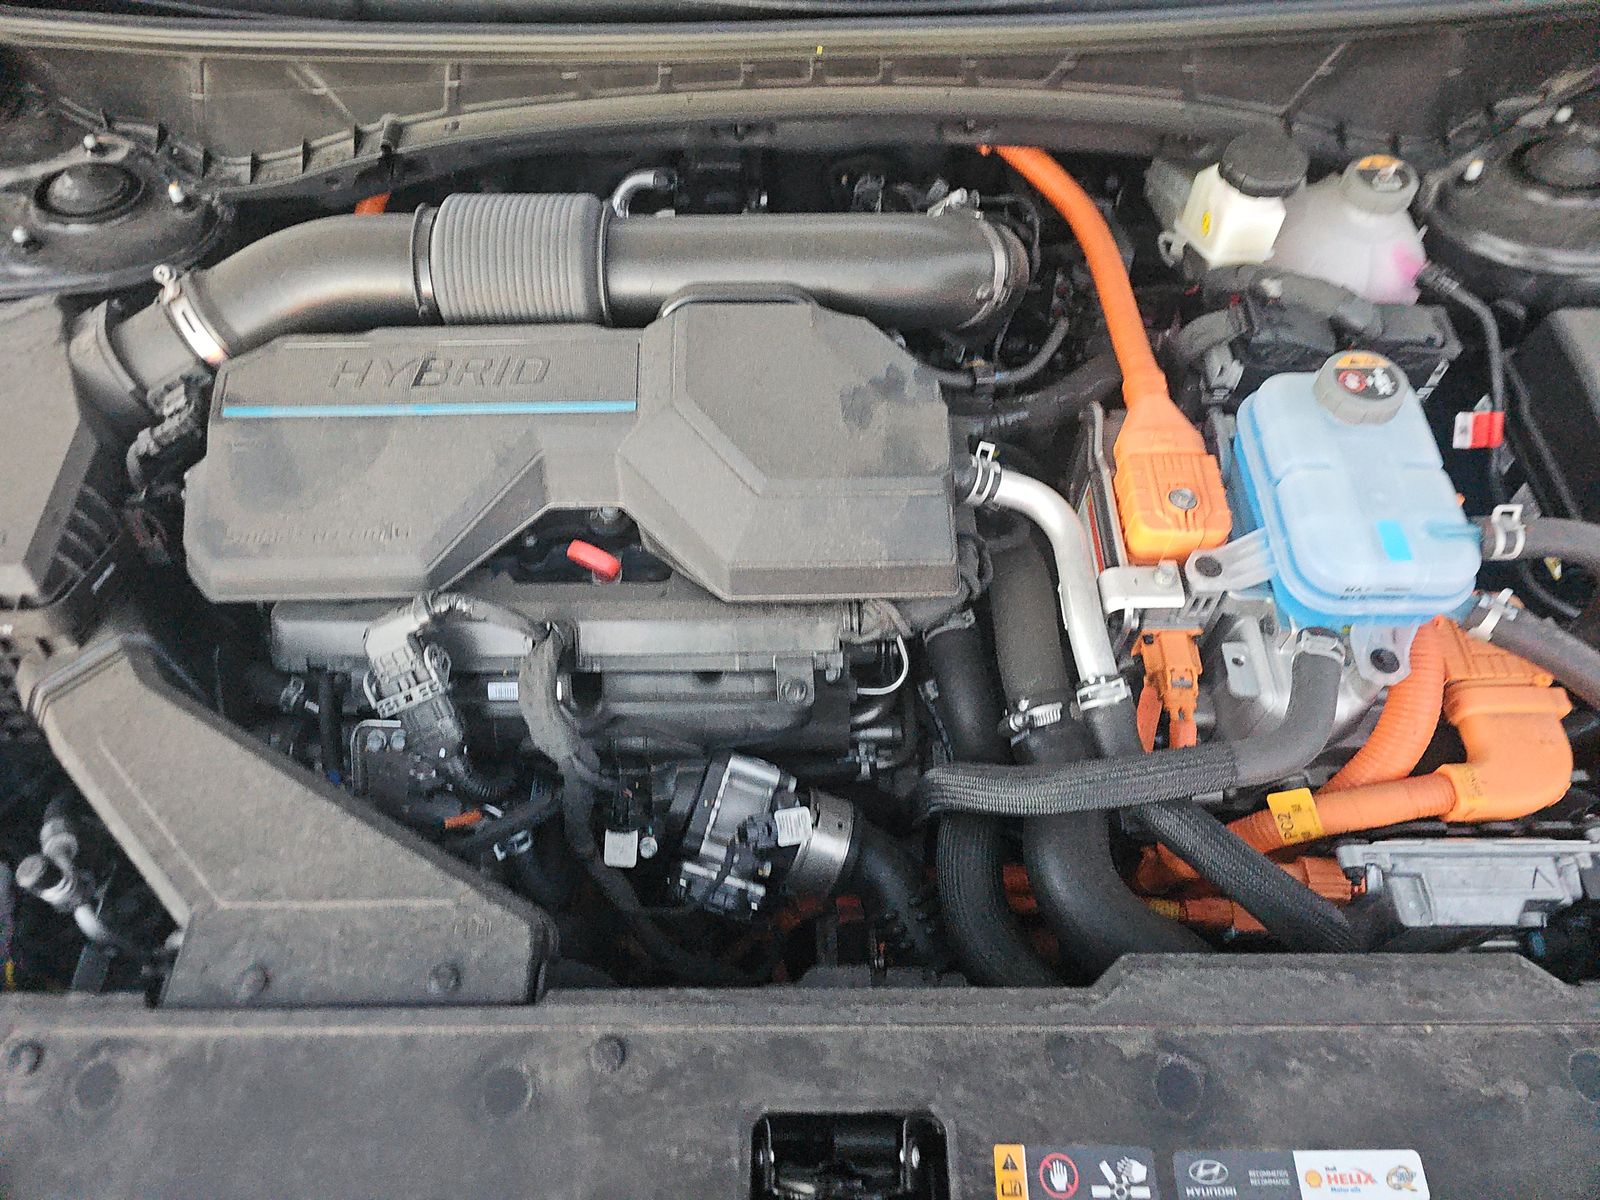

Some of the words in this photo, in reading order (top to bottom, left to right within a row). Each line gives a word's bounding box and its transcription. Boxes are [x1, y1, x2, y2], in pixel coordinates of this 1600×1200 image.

[328, 351, 551, 388] HYBRID
[1326, 1172, 1377, 1185] HELIX
[1186, 1186, 1238, 1197] HYUNDAI
